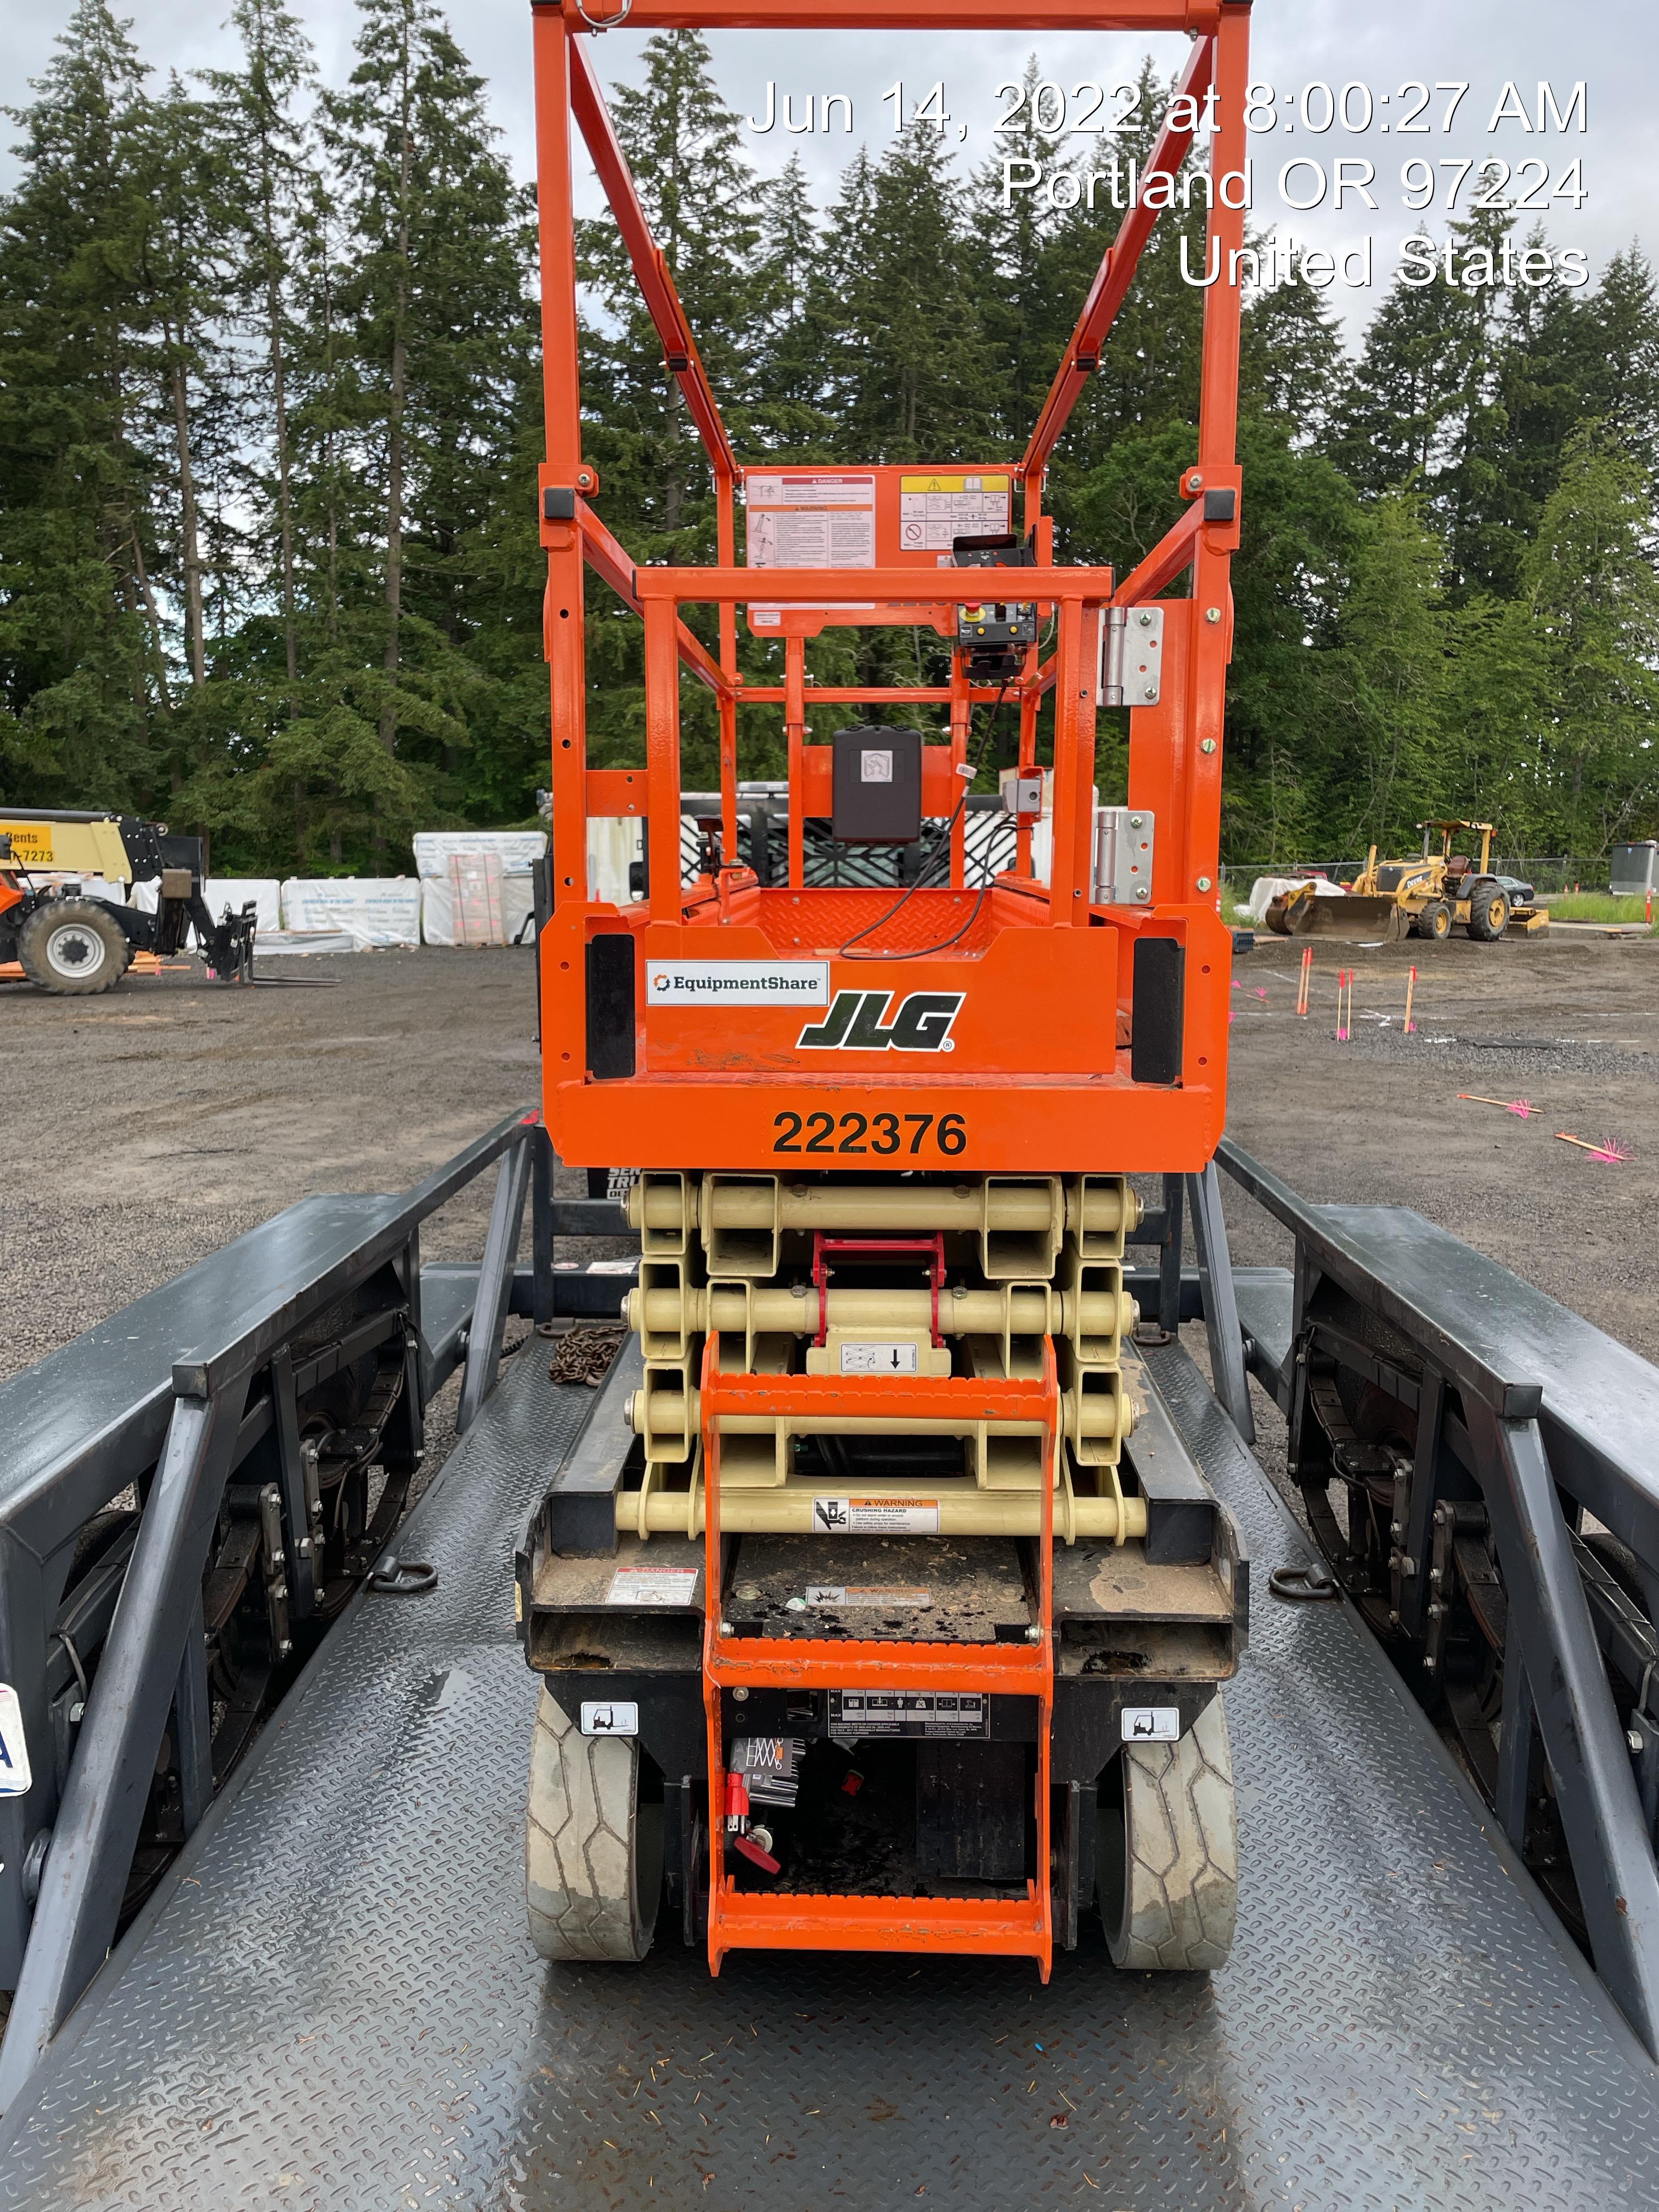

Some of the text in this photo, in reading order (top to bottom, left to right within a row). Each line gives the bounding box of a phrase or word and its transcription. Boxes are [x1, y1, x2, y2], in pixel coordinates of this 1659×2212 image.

[674, 976, 818, 992] EquipmentShare
[795, 990, 967, 1052] JLG
[773, 1111, 967, 1156] 222376
